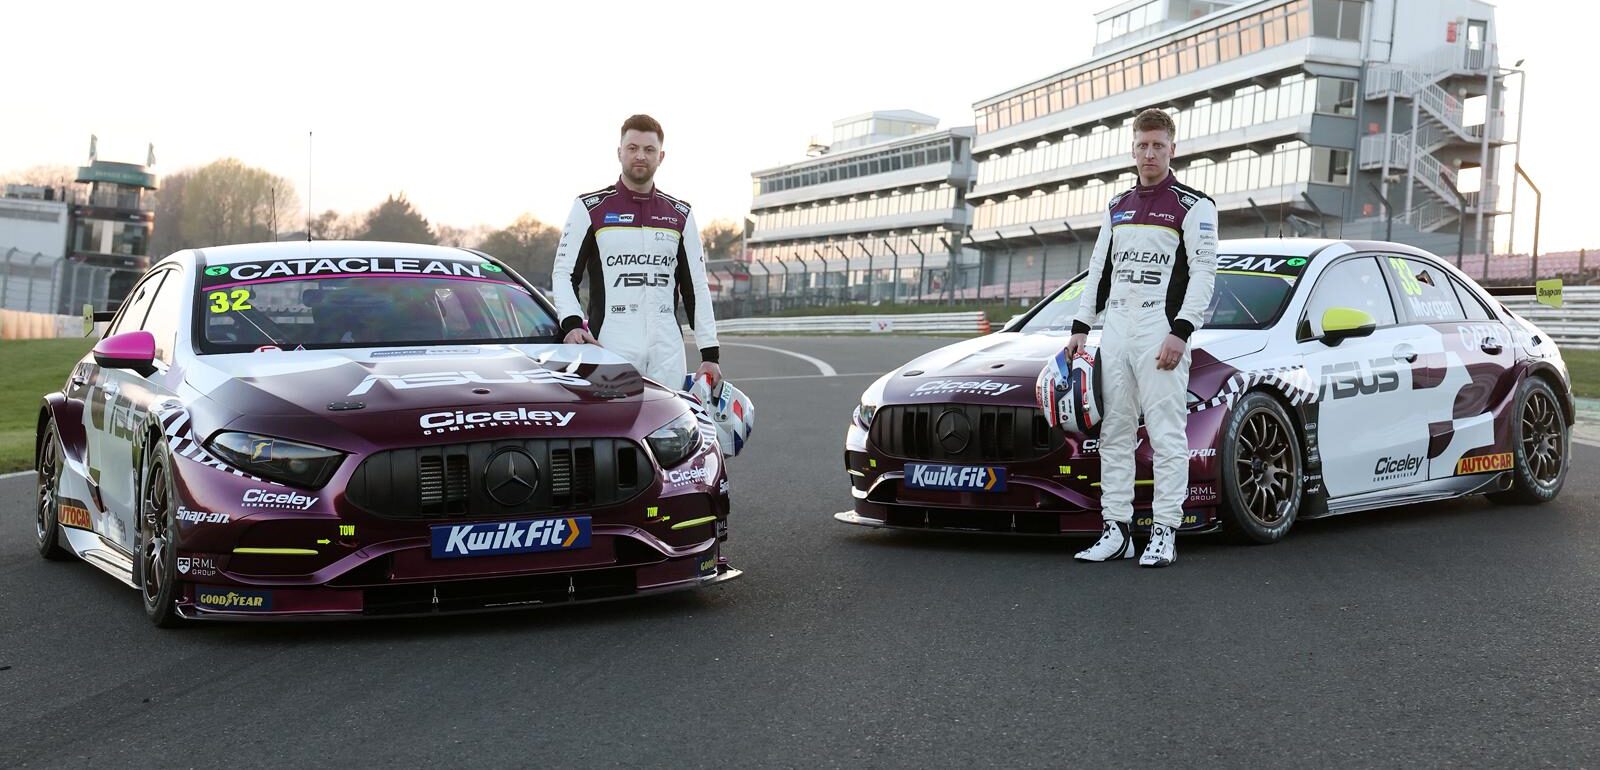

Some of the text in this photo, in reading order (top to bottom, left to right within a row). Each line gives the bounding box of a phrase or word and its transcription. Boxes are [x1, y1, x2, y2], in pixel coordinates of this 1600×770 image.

[230, 258, 482, 280] CATACLEAN
[1388, 257, 1423, 296] 33
[613, 272, 670, 288] ASUS
[209, 289, 252, 314] 32
[1408, 296, 1456, 320] Morgan
[347, 369, 592, 396] ASUS
[915, 379, 1022, 396] Ciceley
[1317, 359, 1400, 402] ASUS
[419, 408, 577, 430] Ciceley
[423, 421, 554, 435] COMMERCIALS
[1059, 465, 1072, 475] TOW
[1374, 453, 1425, 476] Ciceley
[1460, 453, 1512, 473] AUTOCAR
[668, 466, 711, 484] Ciceley
[242, 489, 320, 510] Ciceley
[1190, 486, 1217, 495] RML
[176, 506, 230, 525] Snap-on
[647, 506, 659, 518] TOW
[339, 525, 356, 537] TOW
[192, 557, 216, 569] RML
